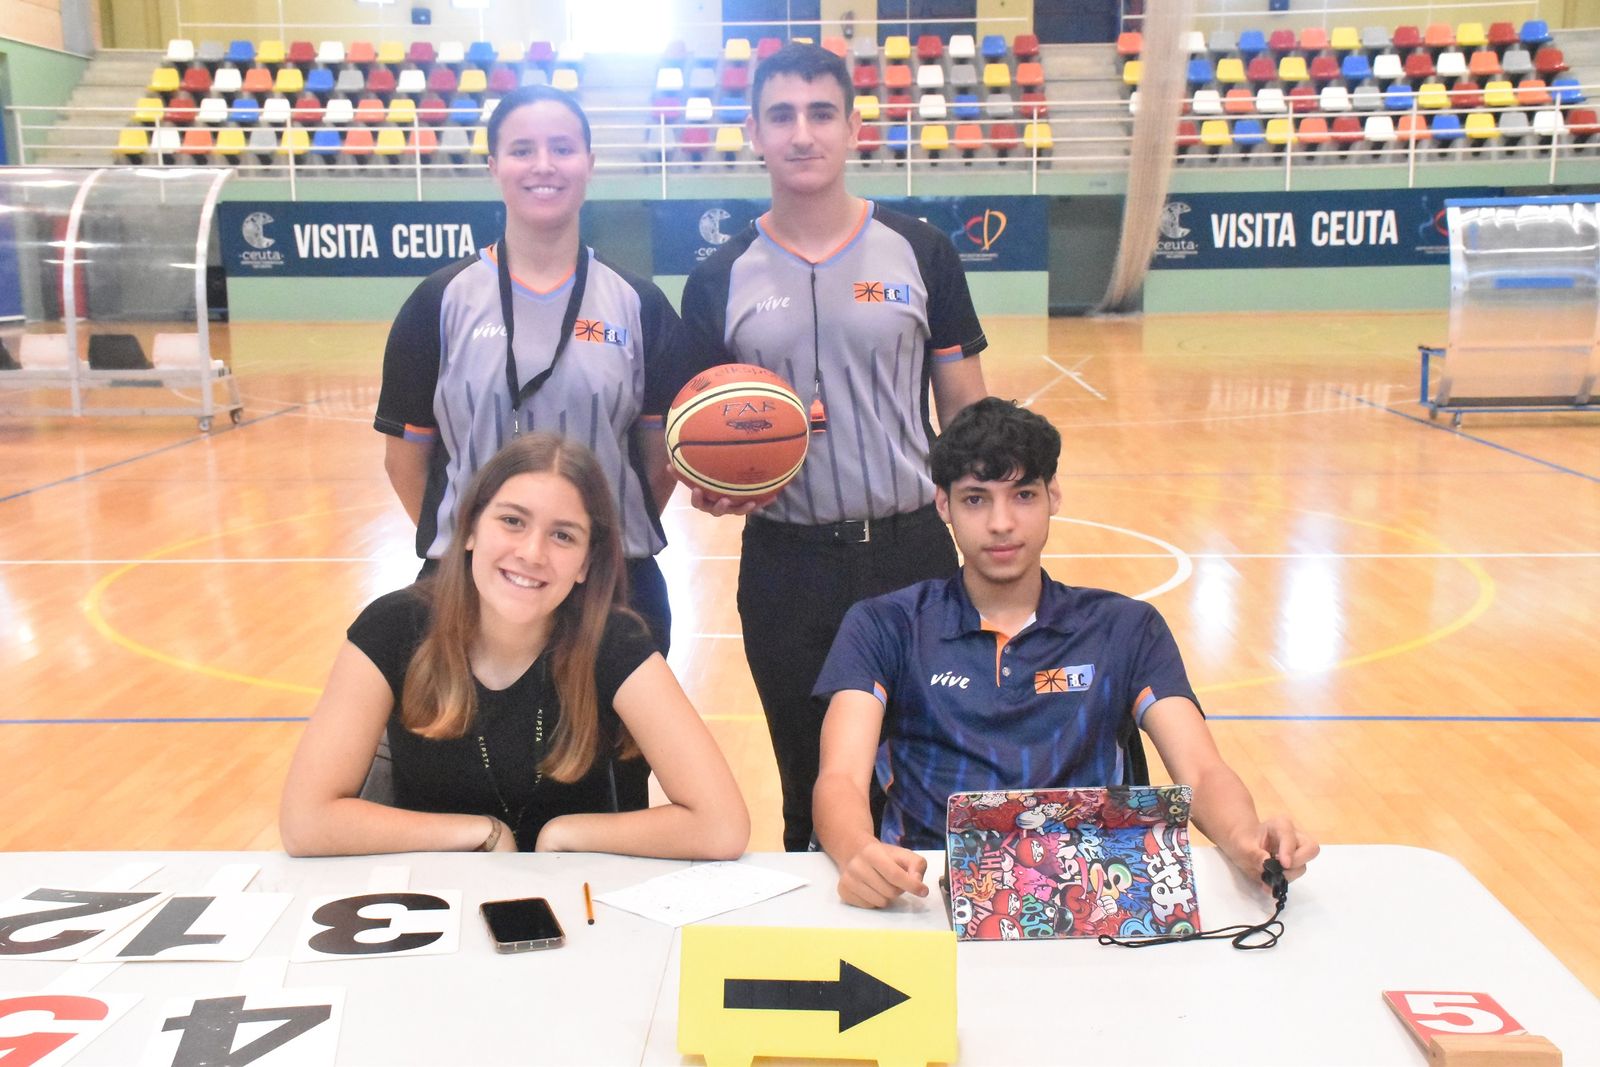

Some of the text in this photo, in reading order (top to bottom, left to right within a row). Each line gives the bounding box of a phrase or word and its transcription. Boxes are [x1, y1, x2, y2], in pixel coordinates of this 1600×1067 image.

[293, 223, 476, 259] VISITA CEUTA
[1211, 209, 1398, 249] VISITA CEUTA
[535, 708, 543, 742] KIPSTA
[478, 735, 490, 769] KIPSTA
[0, 887, 163, 956] 2
[115, 896, 227, 957] 1
[308, 892, 451, 955] 3
[161, 995, 332, 1067] 4
[1404, 993, 1504, 1034] 5
